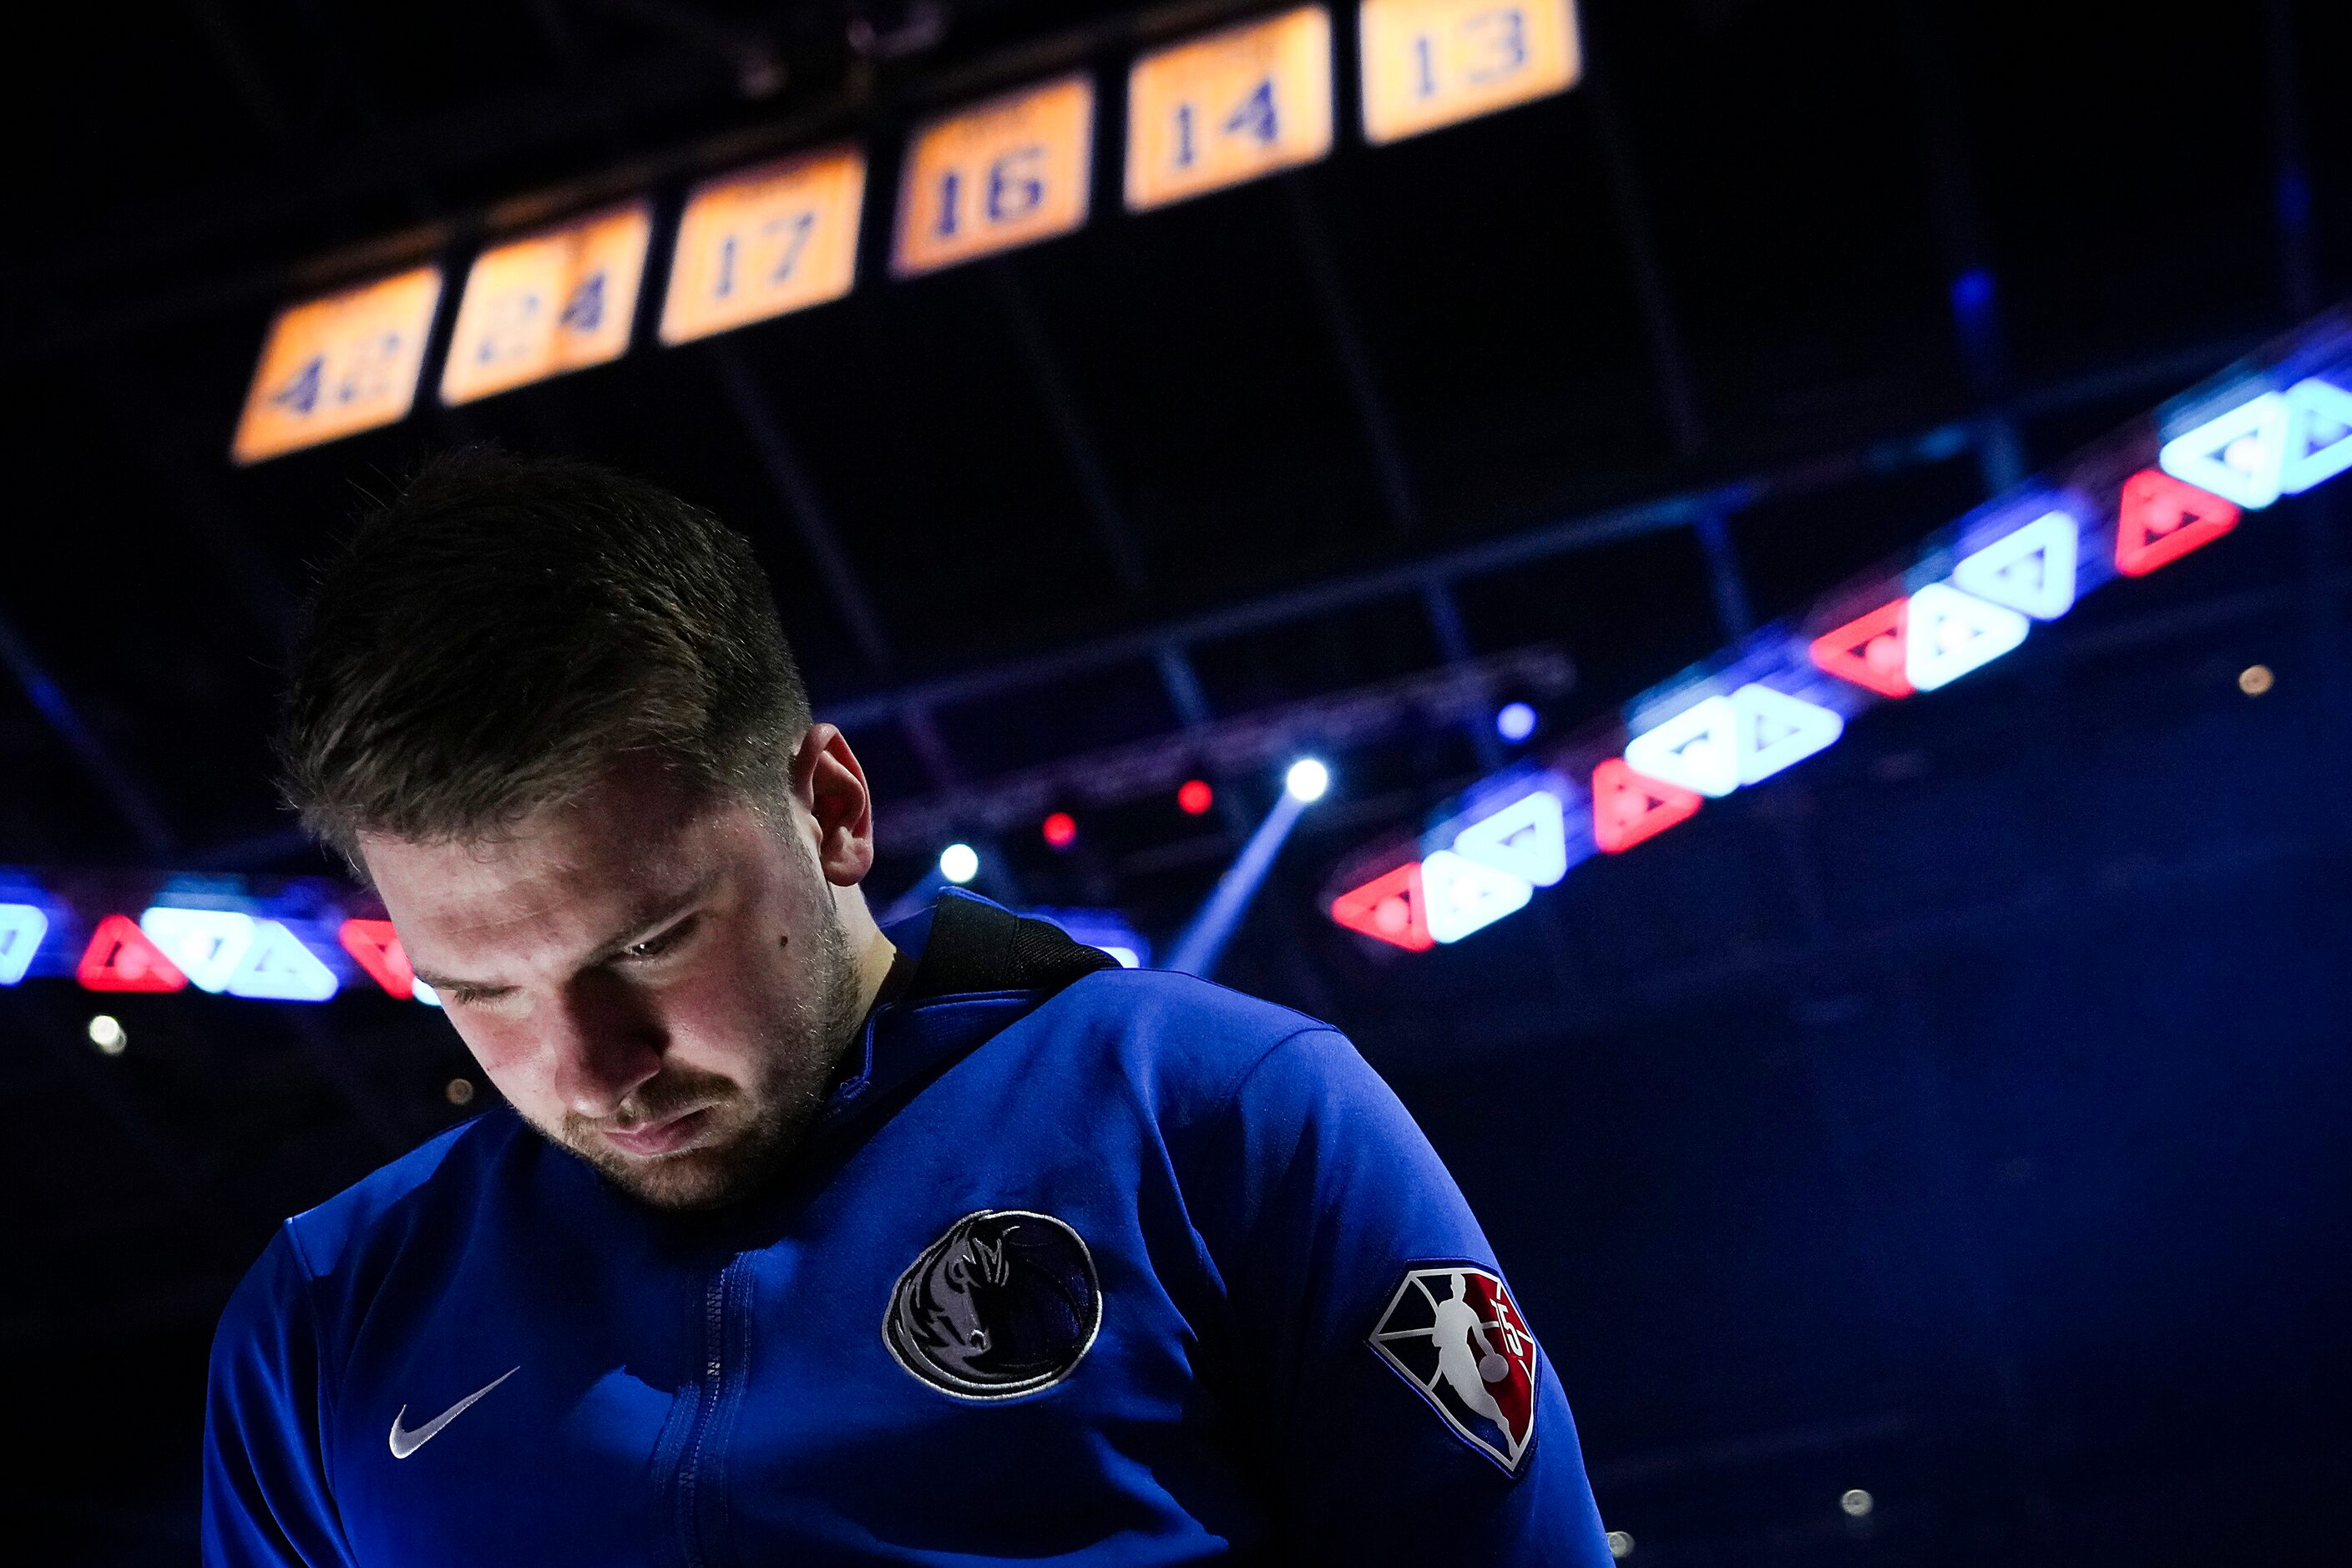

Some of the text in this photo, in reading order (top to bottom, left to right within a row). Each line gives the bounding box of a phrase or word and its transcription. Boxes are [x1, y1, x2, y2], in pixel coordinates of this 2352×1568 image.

[1415, 4, 1528, 98] 13
[1175, 70, 1281, 167] 14
[934, 144, 1045, 240] 16
[713, 210, 817, 300] 17
[476, 268, 609, 366] 24
[274, 331, 404, 415] 42
